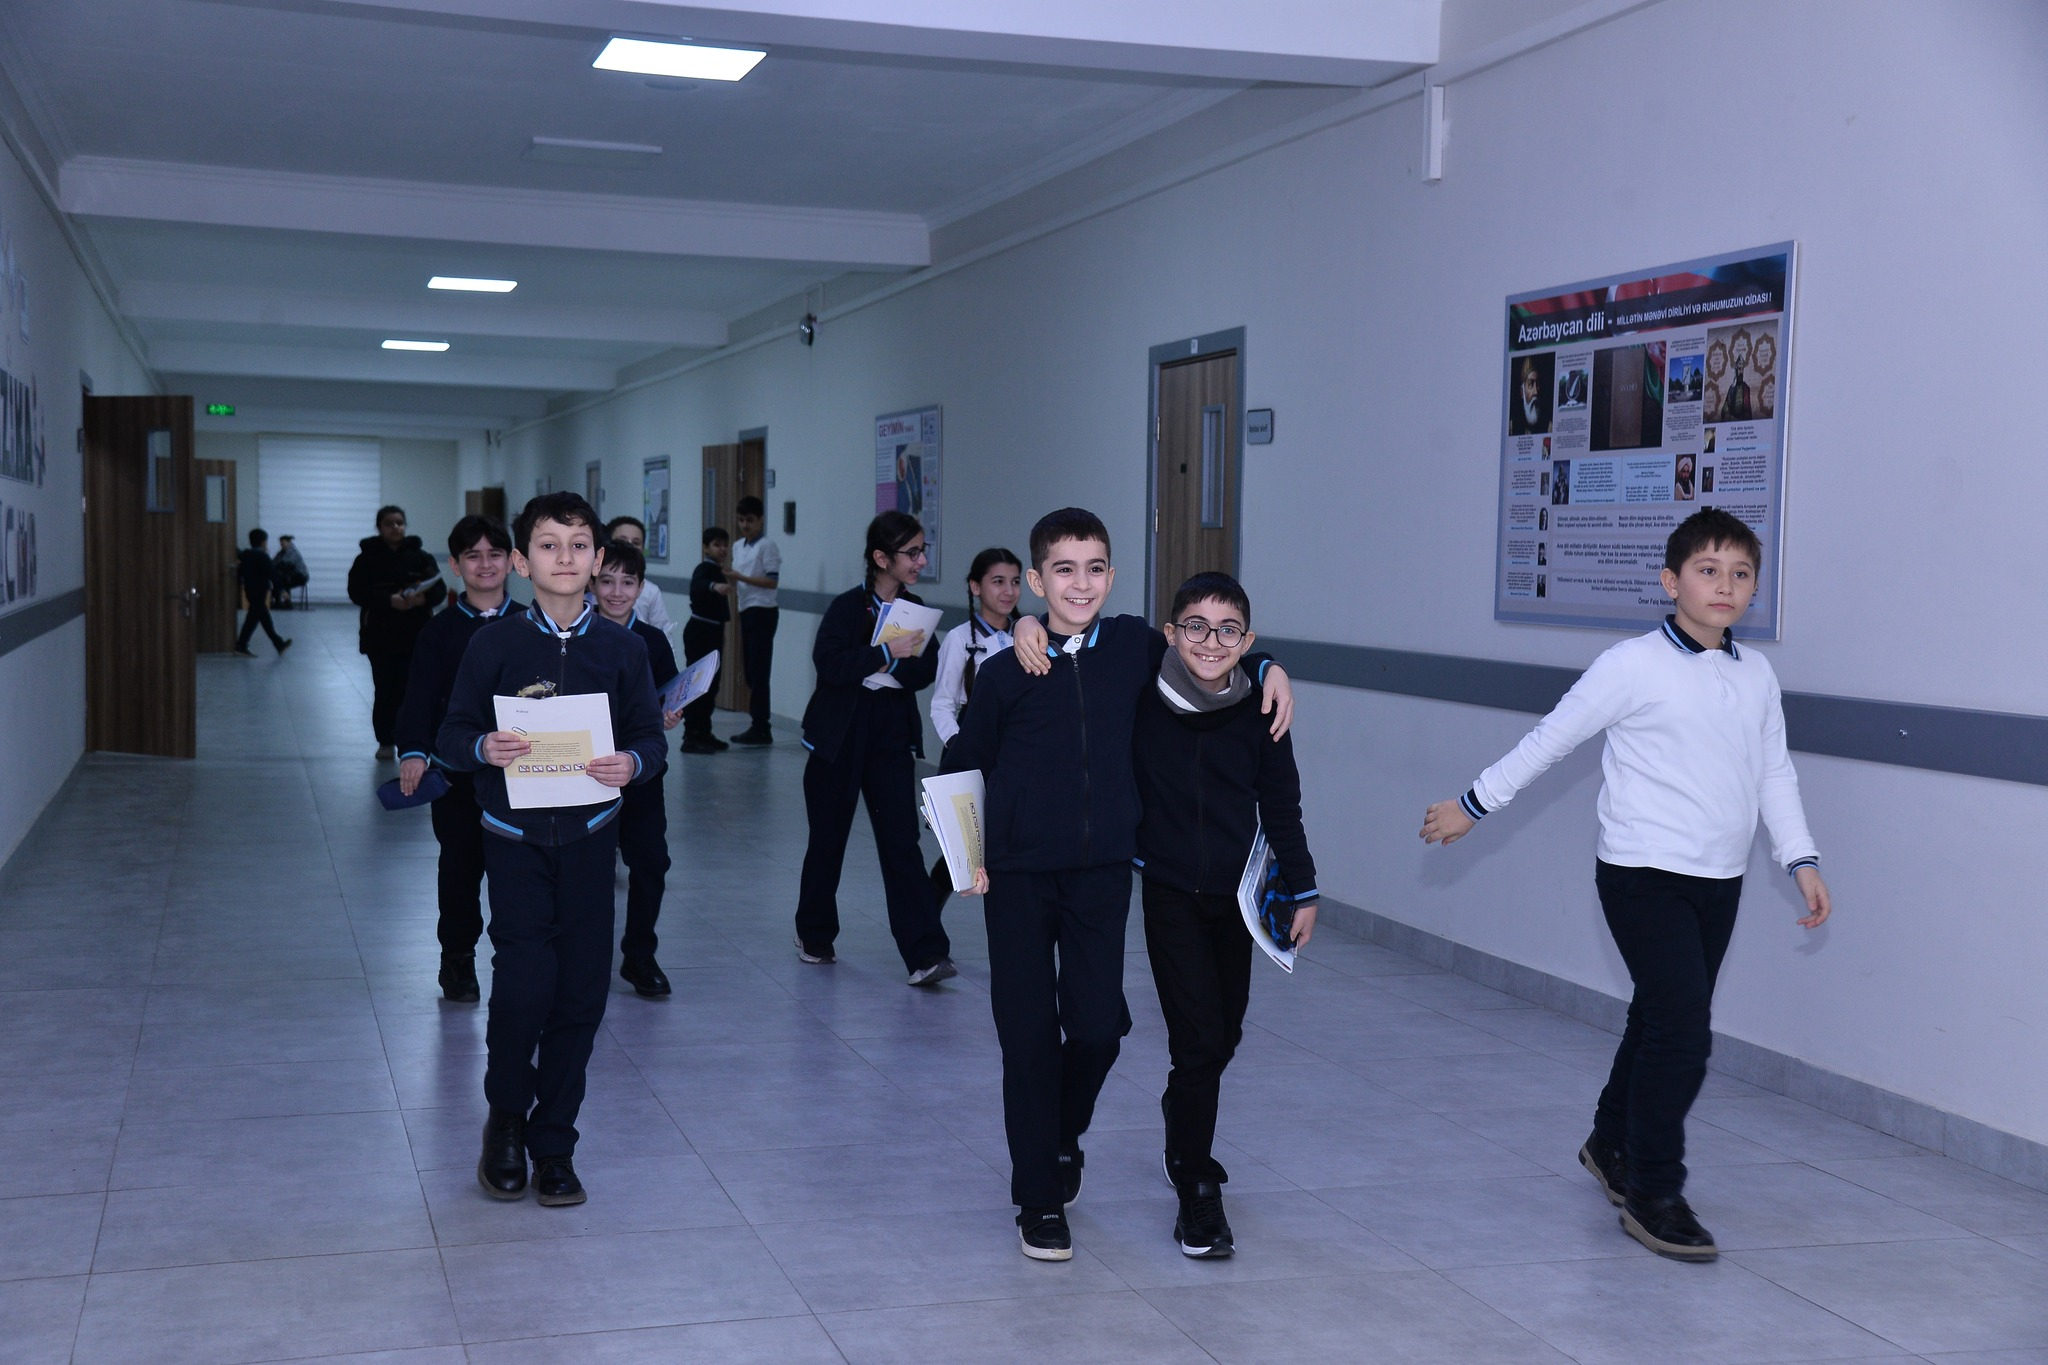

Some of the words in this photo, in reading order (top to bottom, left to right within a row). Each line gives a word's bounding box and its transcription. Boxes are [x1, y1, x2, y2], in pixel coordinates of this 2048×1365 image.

[1518, 321, 1583, 343] Azərbaycan
[1586, 311, 1605, 332] dili
[1616, 312, 1643, 326] MİLLƏTİN
[1643, 307, 1667, 322] MƏNƏVİ
[1668, 303, 1692, 318] DİRİLİYİ
[1692, 303, 1702, 314] VƏ
[1702, 297, 1744, 313] RUHUMUZUN
[1744, 291, 1769, 306] QİDASI
